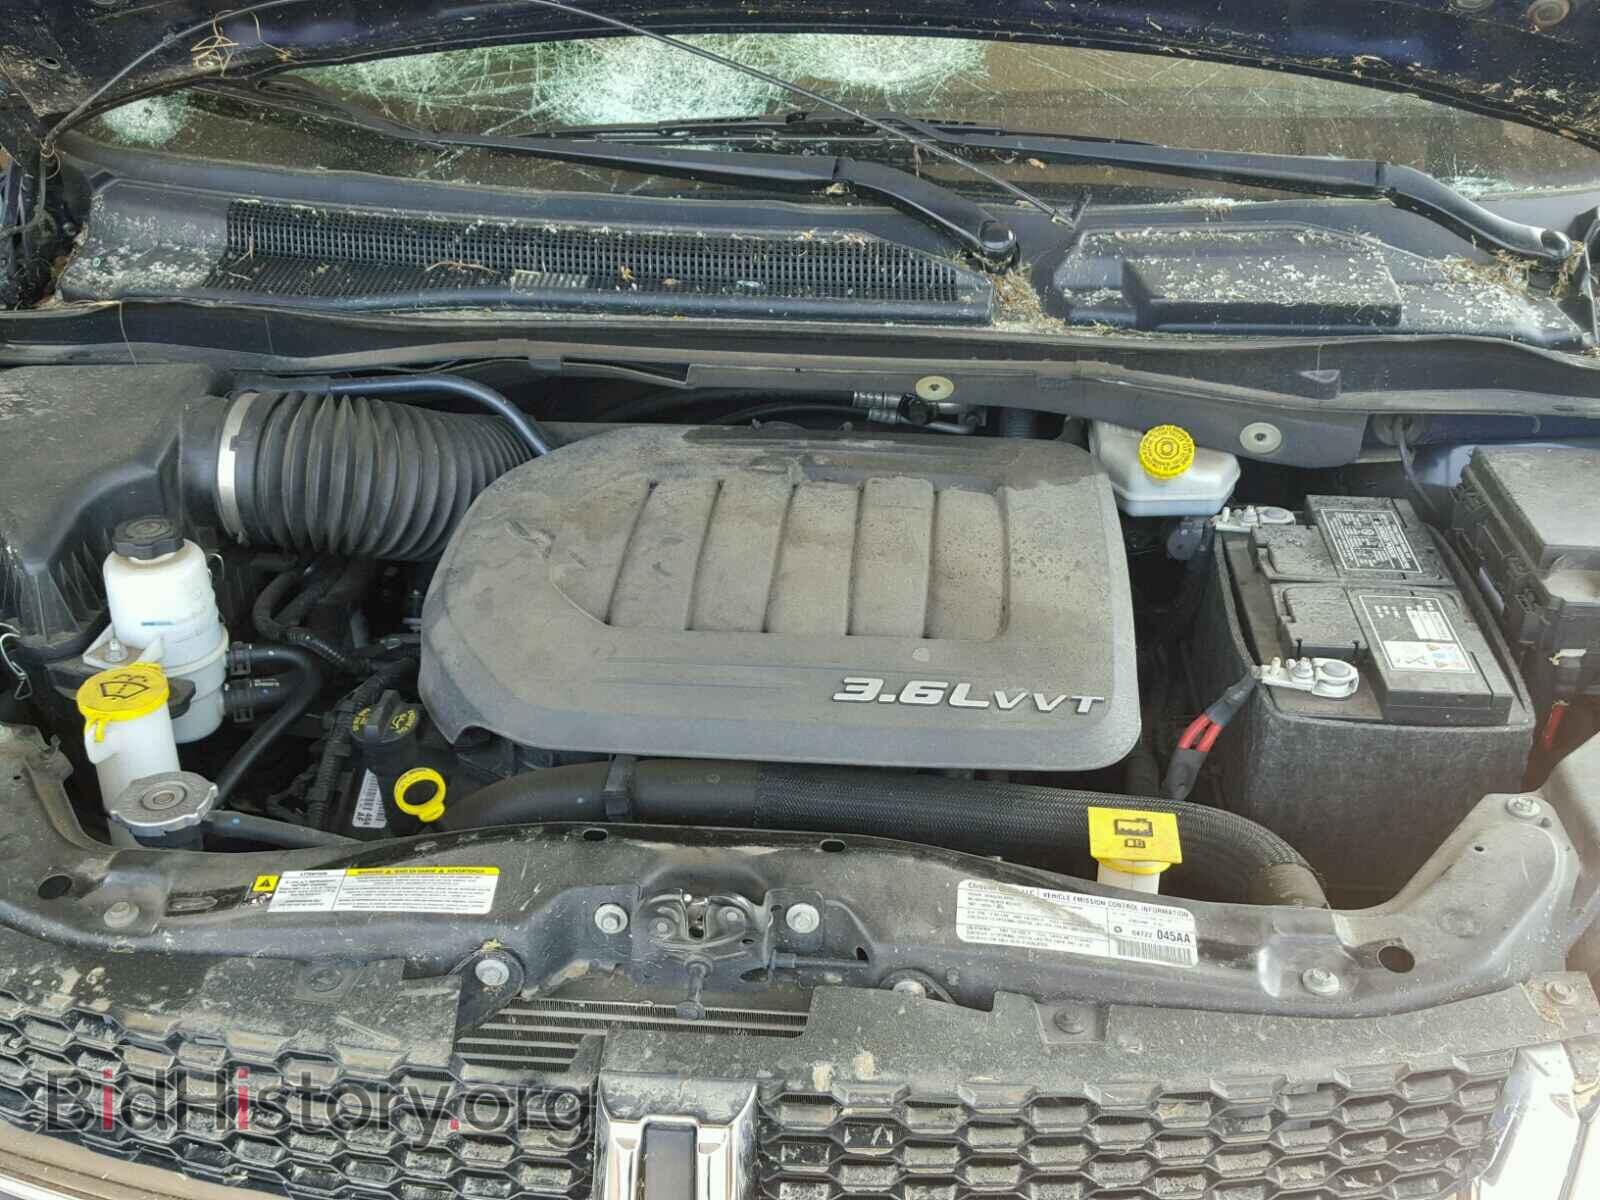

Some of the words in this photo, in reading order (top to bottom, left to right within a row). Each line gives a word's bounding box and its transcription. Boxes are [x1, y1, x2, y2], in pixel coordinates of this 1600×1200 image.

[832, 676, 990, 708] 3.6L
[994, 689, 1105, 714] VVT
[1073, 895, 1106, 905] EMISSION
[1108, 901, 1138, 911] CONTROL
[1141, 905, 1189, 917] INFORMATION
